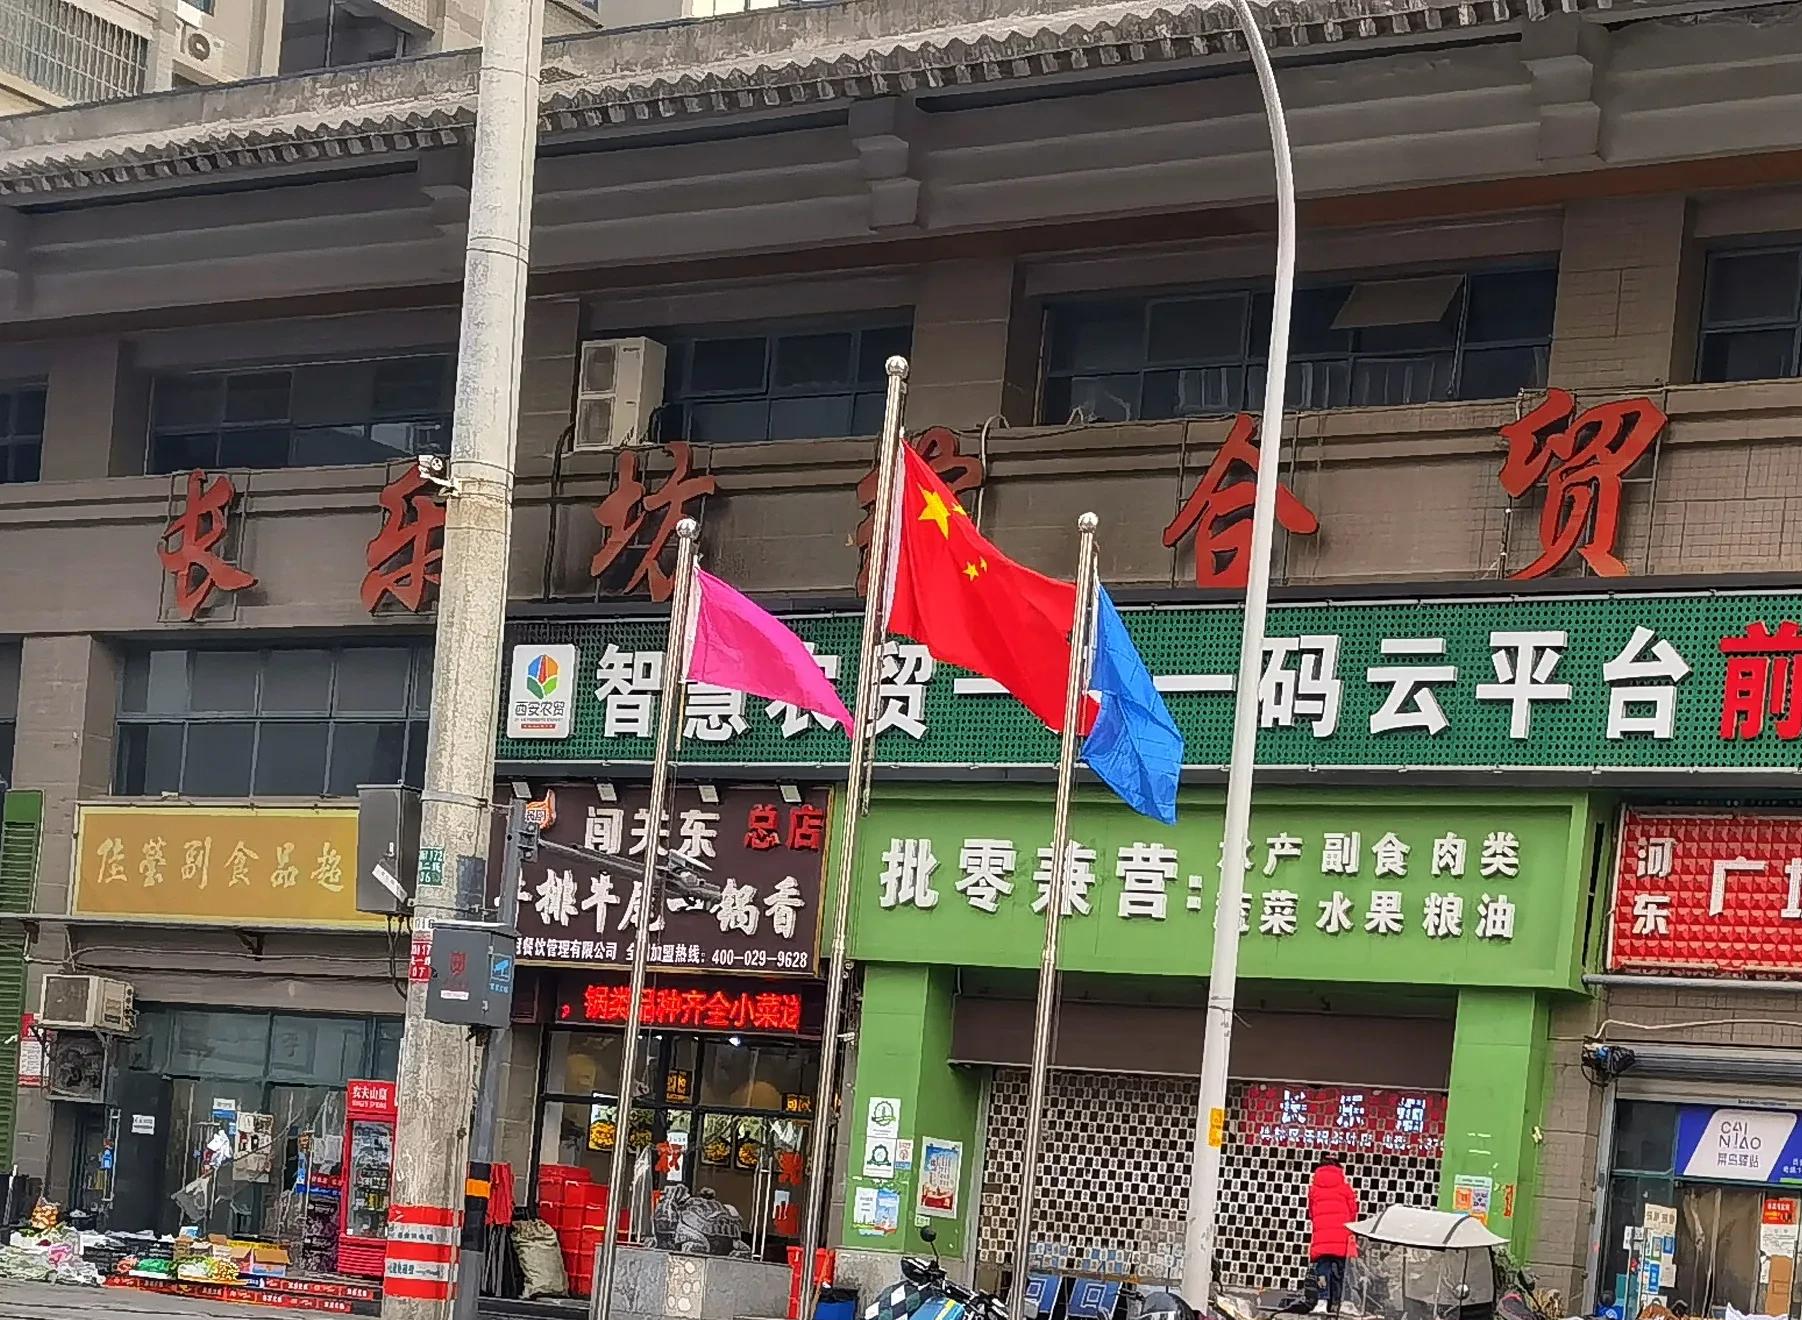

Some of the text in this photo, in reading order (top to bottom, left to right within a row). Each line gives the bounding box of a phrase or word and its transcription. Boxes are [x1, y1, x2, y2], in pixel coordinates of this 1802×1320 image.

[515, 701, 565, 716] 西安农贸
[584, 803, 826, 858] 闯关东 总店
[1632, 837, 1678, 935] 河东
[626, 941, 808, 968] 全加盟热线：400-029-9628
[1721, 1121, 1748, 1135] CAI
